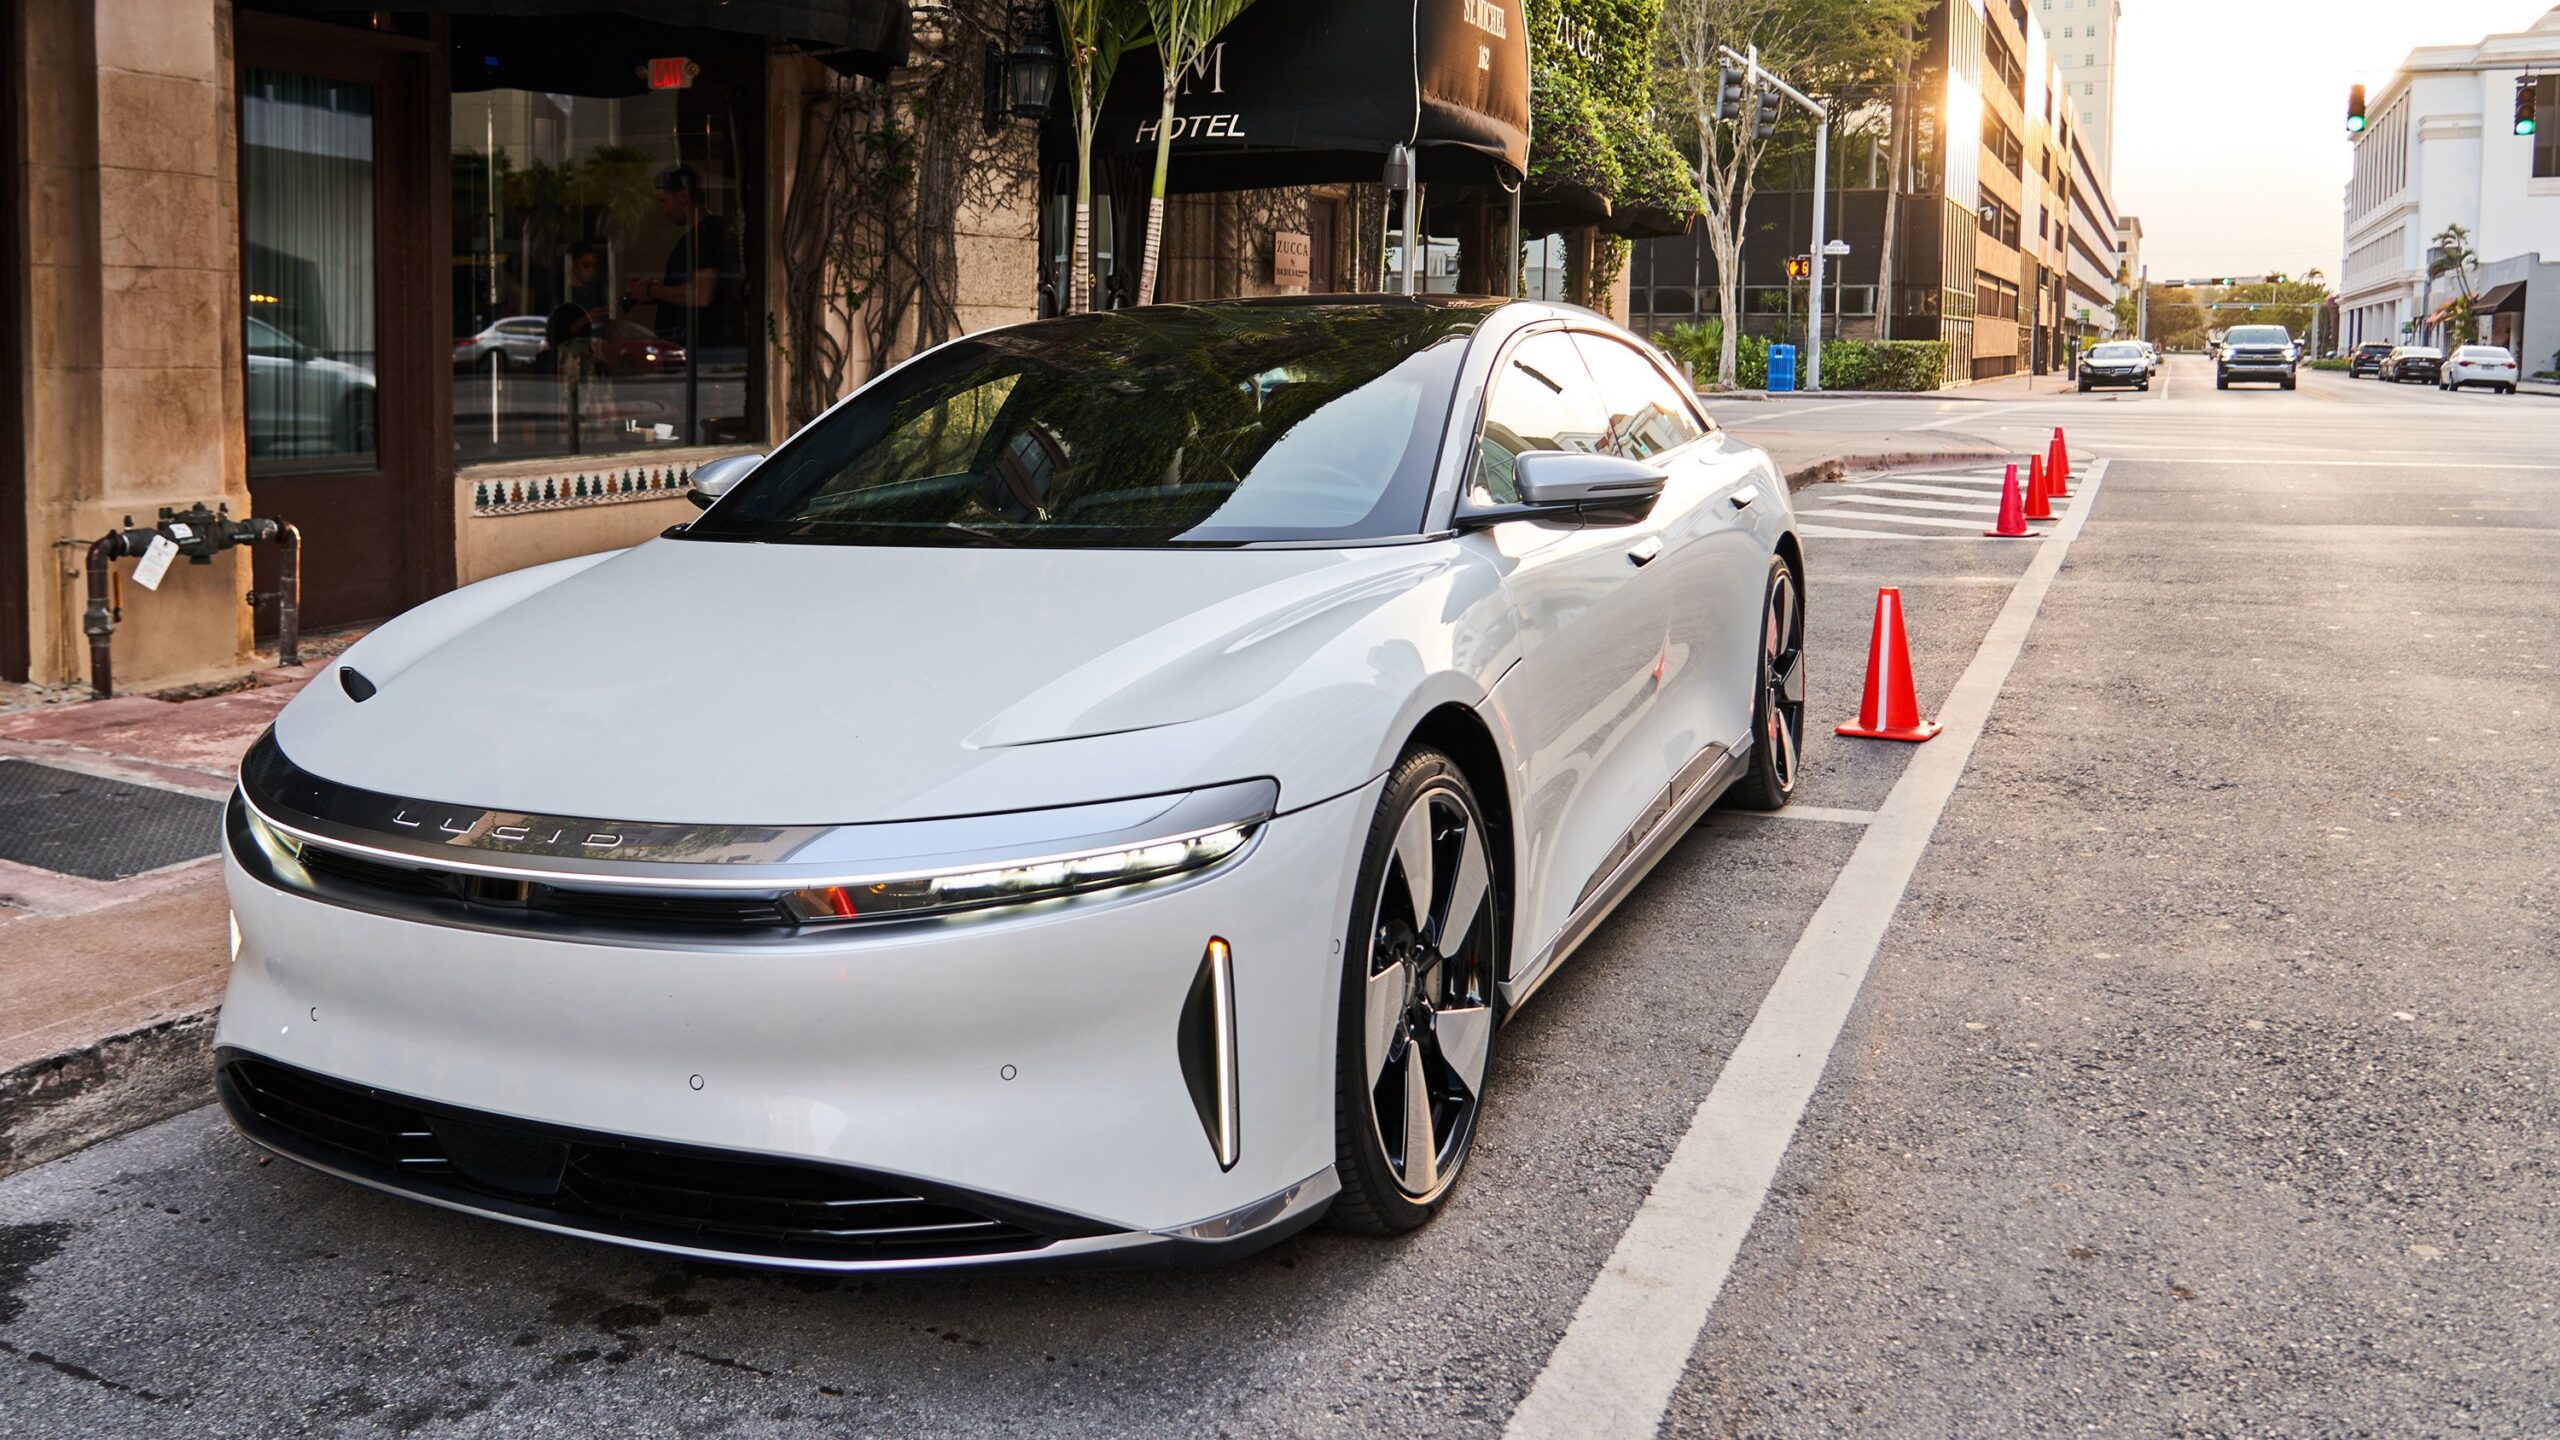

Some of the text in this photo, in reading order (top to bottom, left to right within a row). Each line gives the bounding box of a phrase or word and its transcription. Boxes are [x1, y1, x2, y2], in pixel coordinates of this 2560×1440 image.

[1476, 0, 1506, 40] MICHEL
[655, 58, 684, 87] EXIT
[1135, 114, 1245, 143] HOTEL
[1277, 240, 1308, 256] ZUCCA
[393, 810, 574, 847] LUCID
